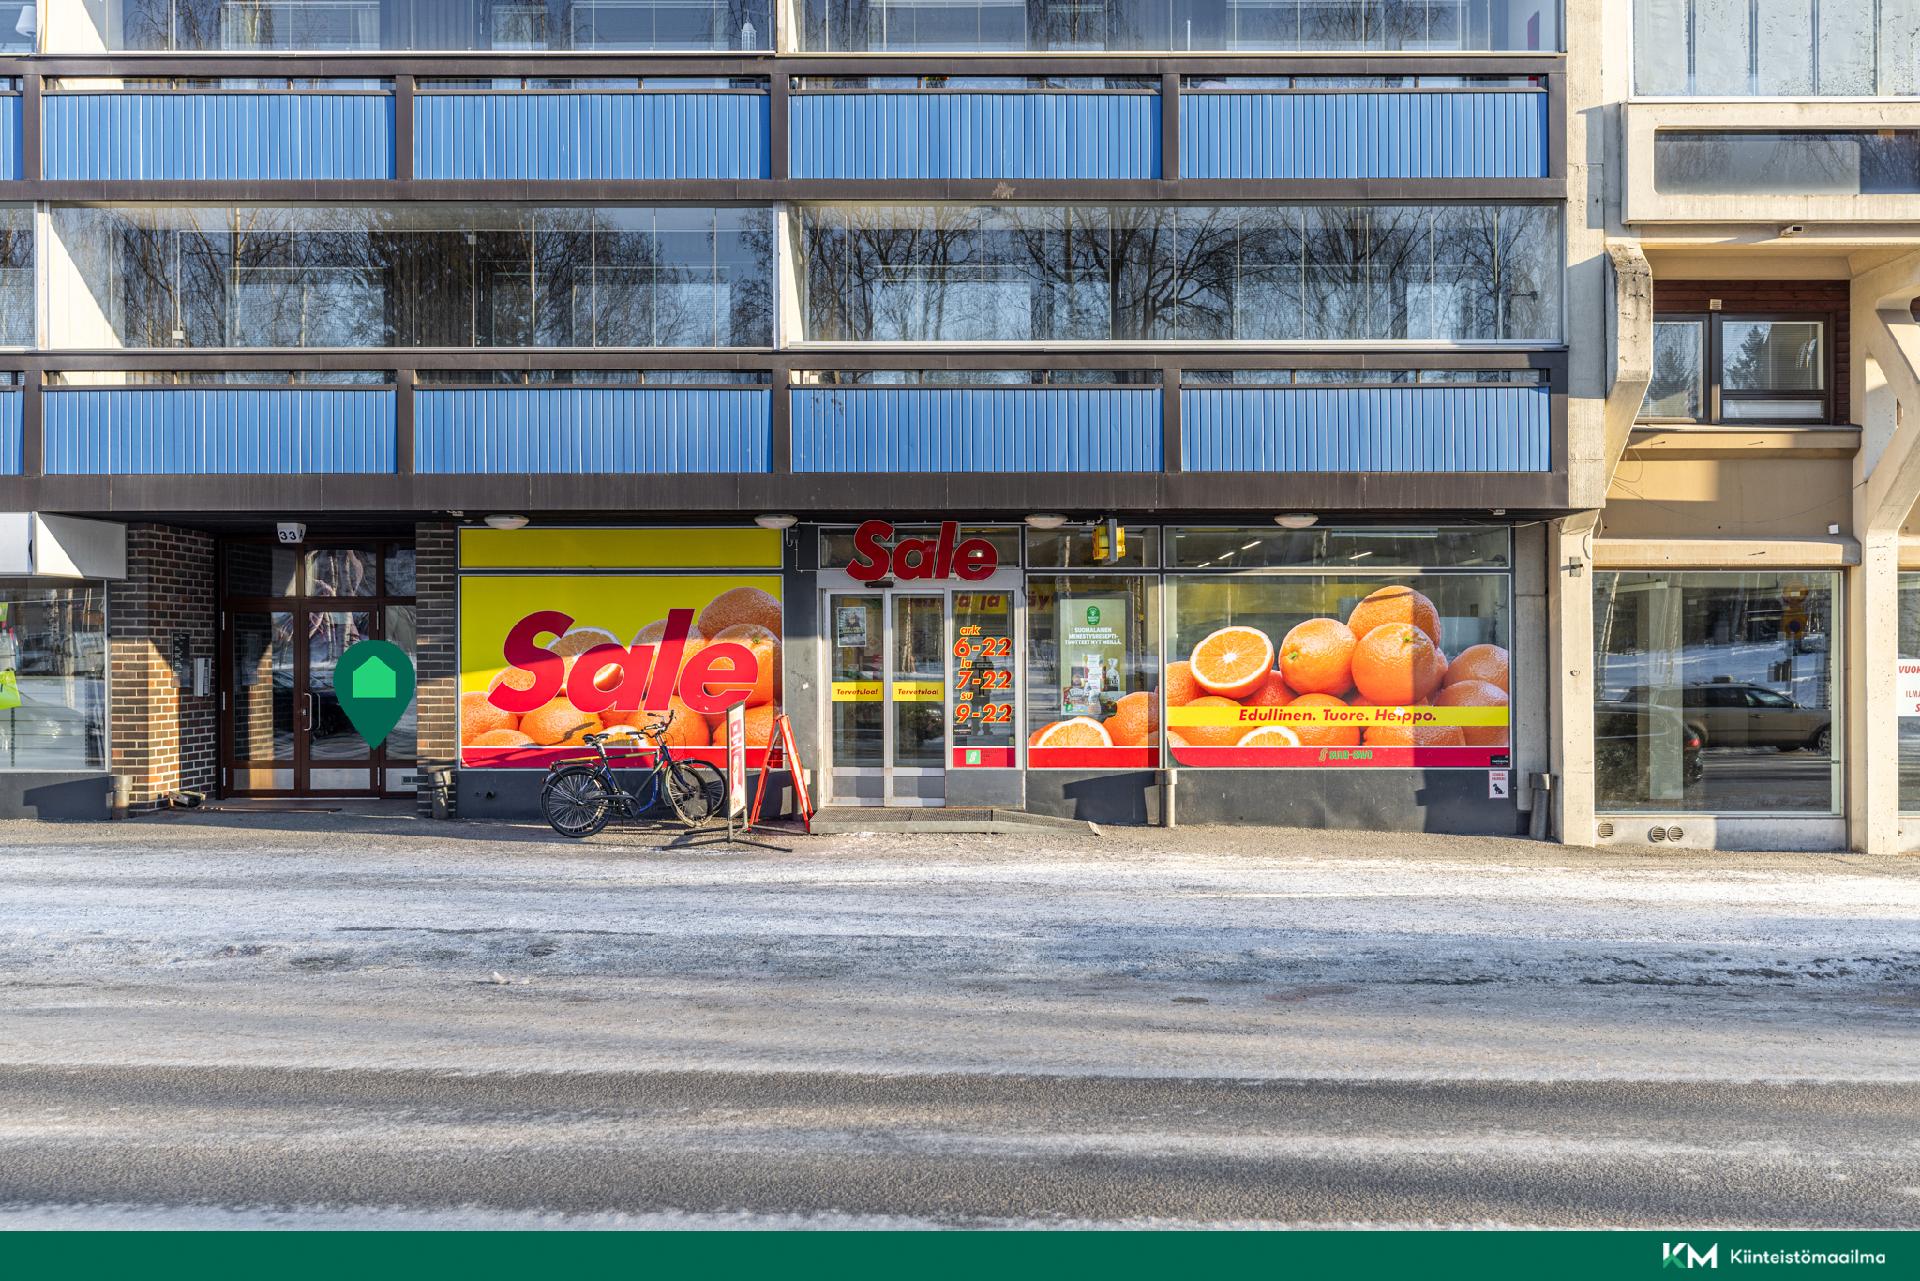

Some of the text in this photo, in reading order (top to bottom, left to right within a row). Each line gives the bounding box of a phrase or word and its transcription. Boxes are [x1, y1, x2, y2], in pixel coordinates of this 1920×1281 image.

[845, 519, 998, 581] Sale
[960, 625, 981, 636] ark
[488, 608, 759, 714] Sale
[961, 657, 972, 669] la
[960, 691, 973, 701] su
[1239, 708, 1316, 721] Edullinen.
[1323, 708, 1369, 721] Tuore.
